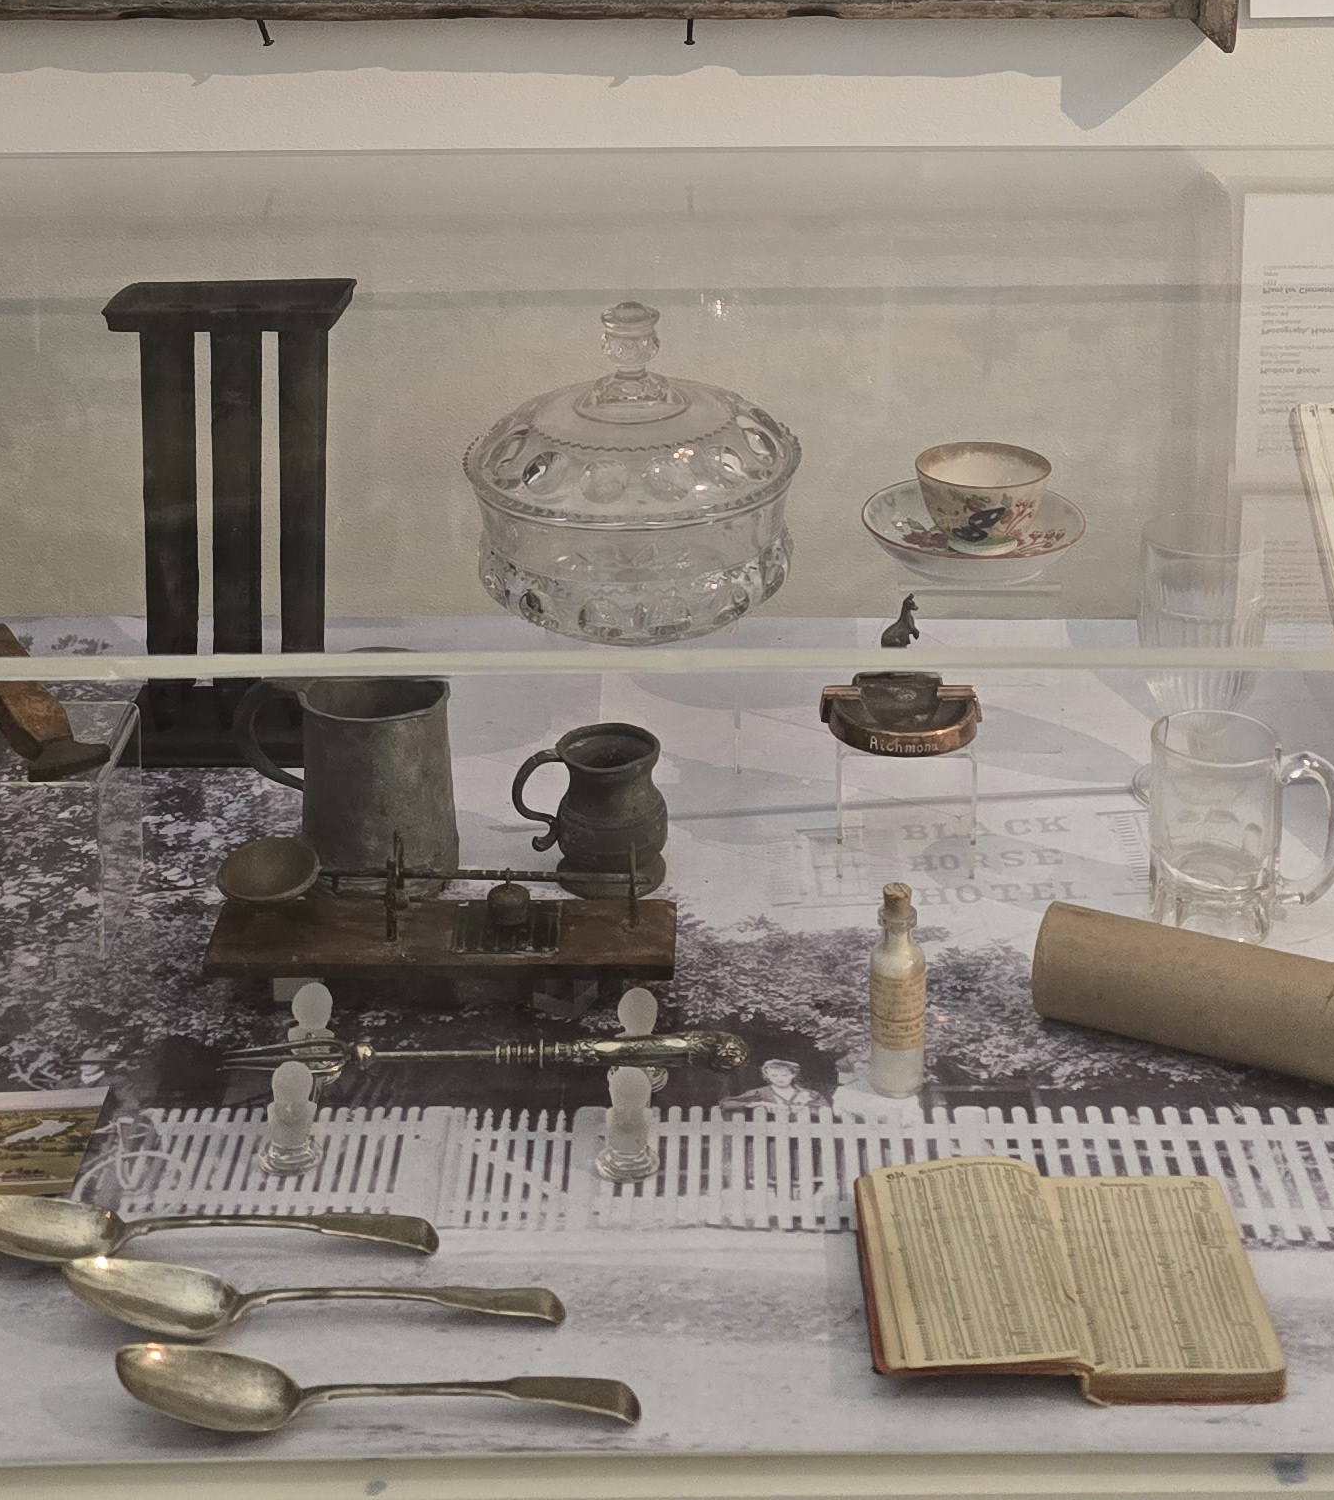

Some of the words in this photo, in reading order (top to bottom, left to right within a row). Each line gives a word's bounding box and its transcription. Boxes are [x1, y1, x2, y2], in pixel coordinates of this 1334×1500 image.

[901, 815, 1072, 841] BLACK
[909, 849, 1064, 872] HORSE
[917, 881, 1088, 905] HOTEL
